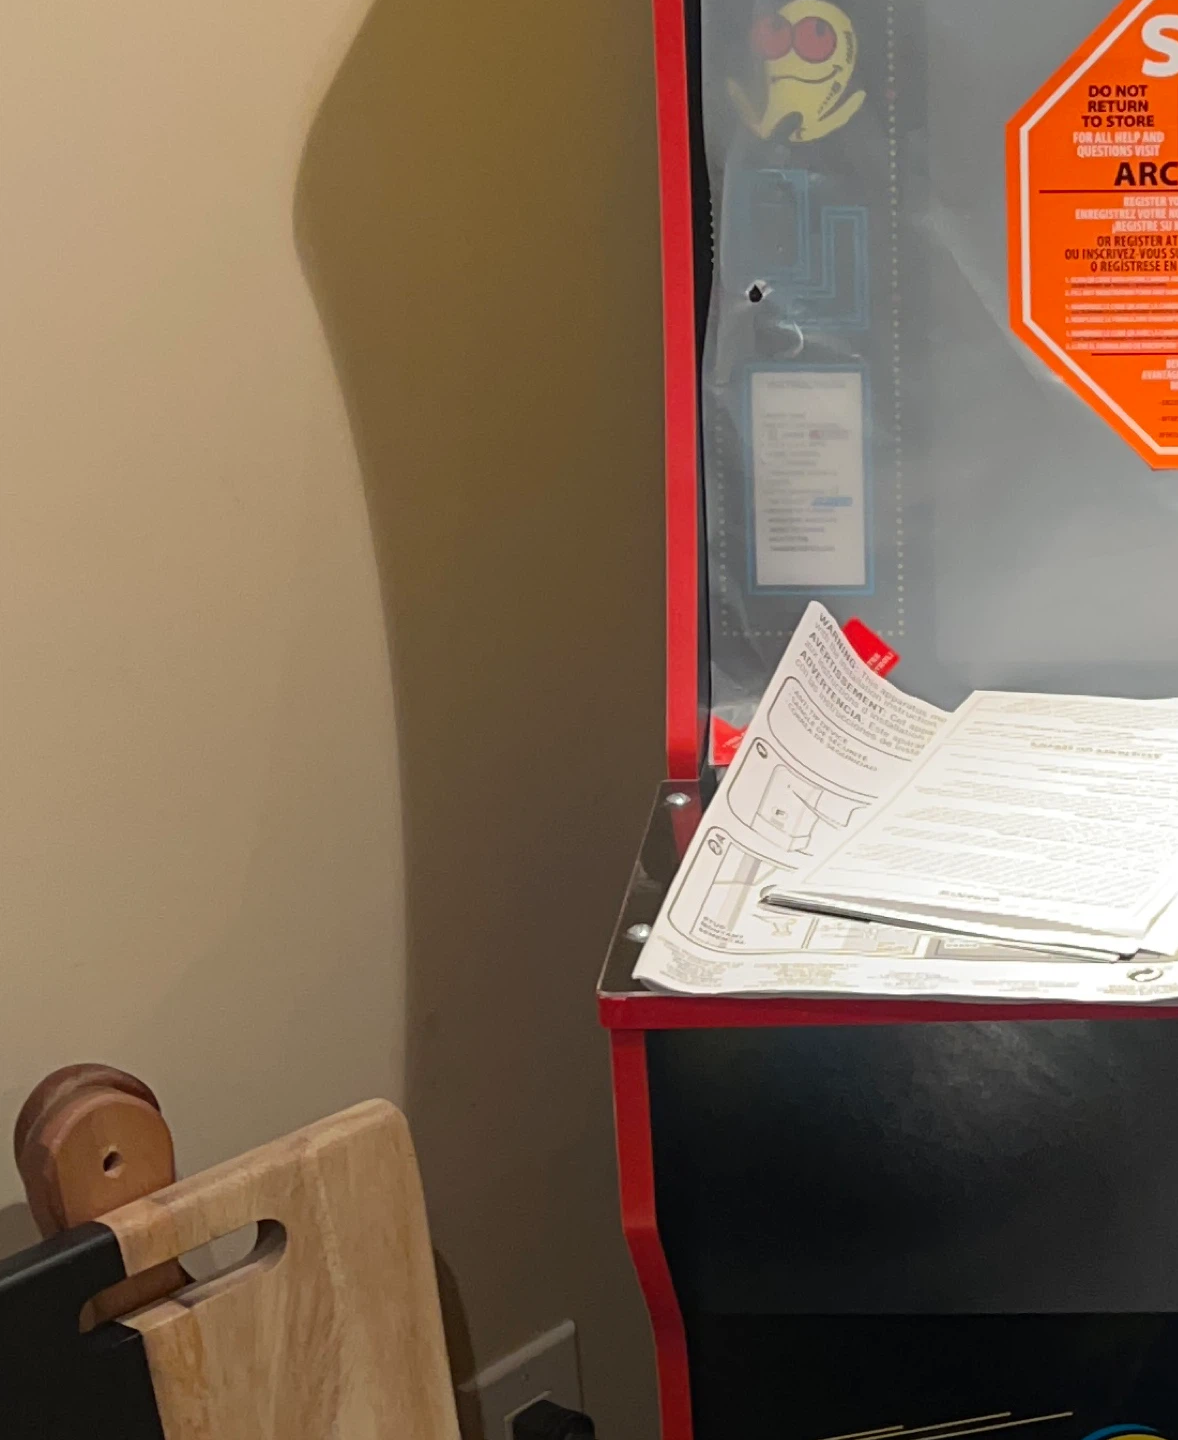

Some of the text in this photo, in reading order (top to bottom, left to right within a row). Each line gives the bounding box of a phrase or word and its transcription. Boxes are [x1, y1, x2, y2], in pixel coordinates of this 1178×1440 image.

[1088, 84, 1148, 97] DO NOT
[1088, 100, 1149, 112] RETURN
[1081, 115, 1154, 127] TO STORE
[1073, 131, 1164, 143] FOR ALL HELP AND
[1077, 144, 1160, 157] QUESTIONS VISIT
[1097, 236, 1111, 247] OR
[1114, 235, 1163, 247] REGISTER
[1165, 235, 1178, 246] AT
[1065, 249, 1079, 260] OU
[1090, 262, 1098, 273] O
[1164, 260, 1177, 272] EN
